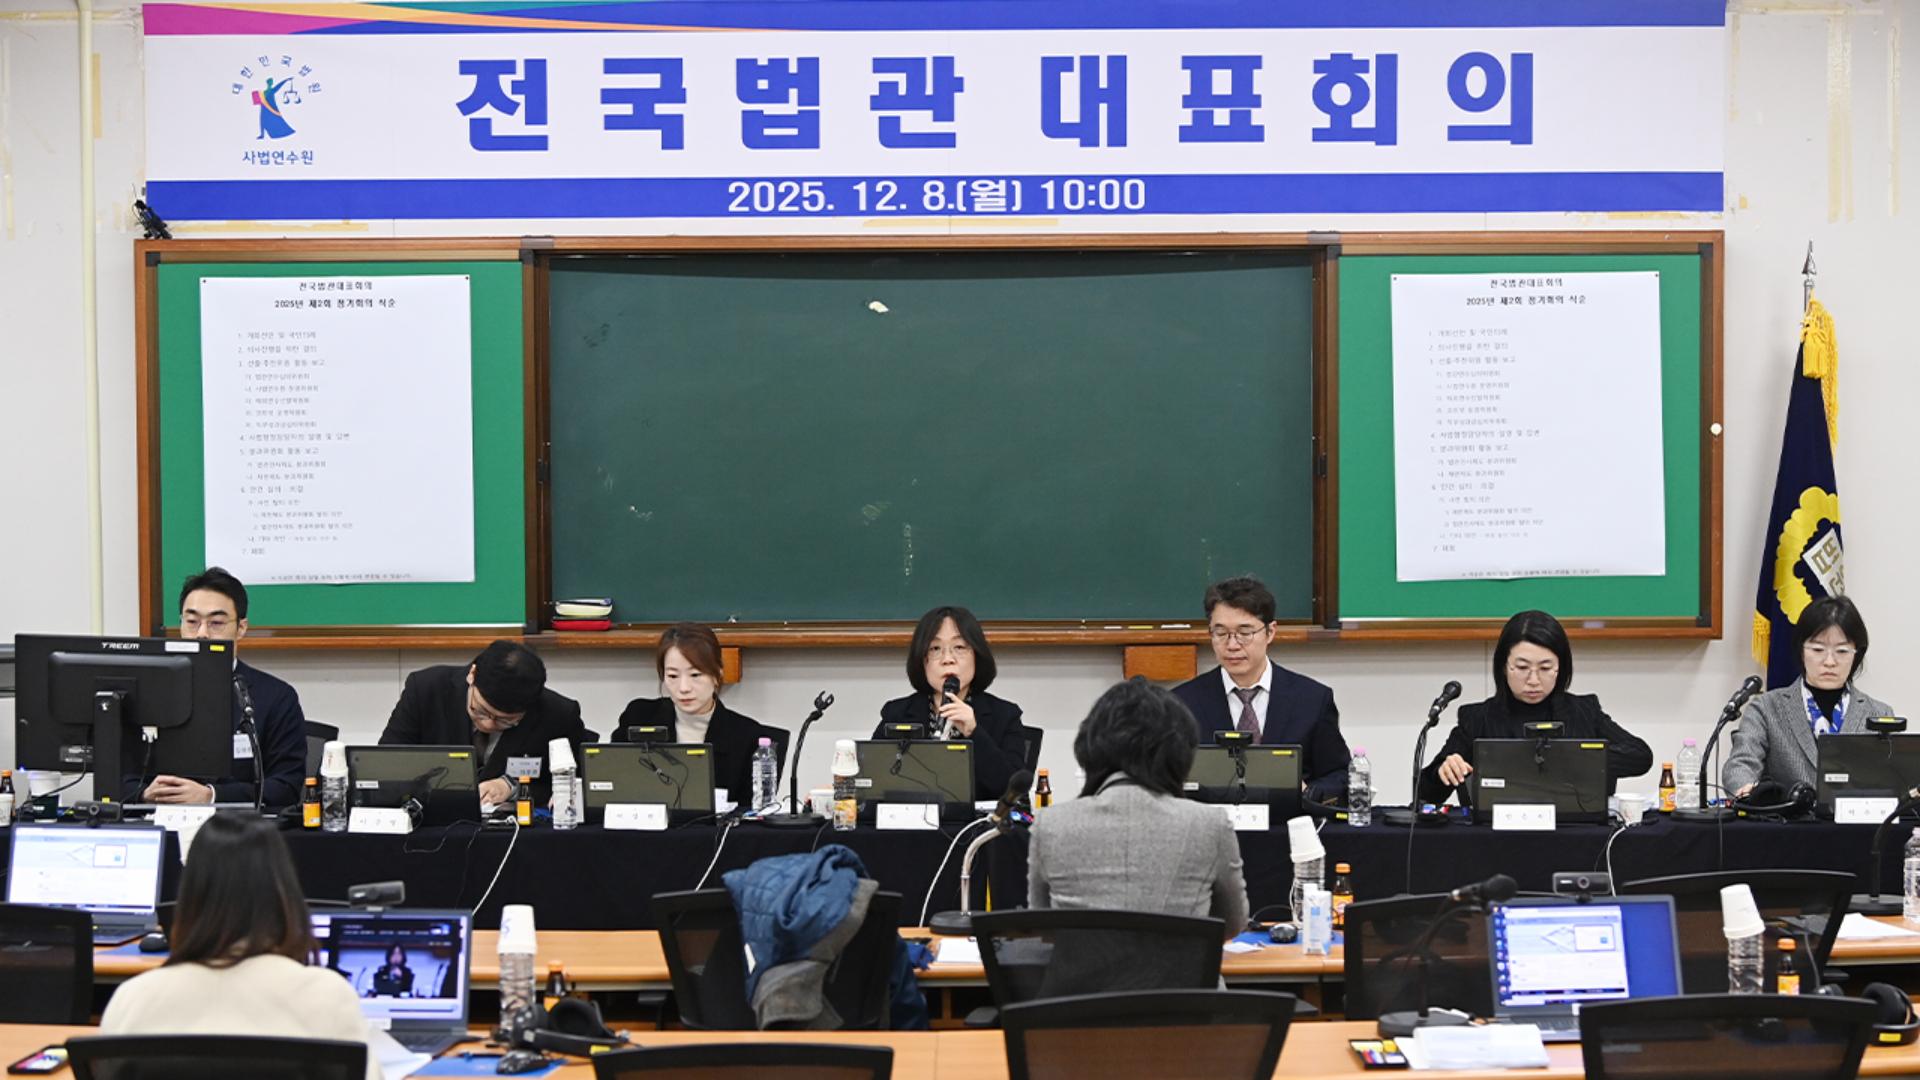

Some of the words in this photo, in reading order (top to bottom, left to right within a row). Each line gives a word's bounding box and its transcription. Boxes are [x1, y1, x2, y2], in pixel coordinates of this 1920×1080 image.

[231, 54, 322, 95] 대한민국법원
[242, 149, 314, 166] 사법연수원
[728, 181, 834, 213] 2025.
[853, 181, 908, 212] 12.
[1041, 179, 1146, 212] 10:00
[299, 281, 373, 292] 전국법관대표회의
[1490, 278, 1563, 289] 전국법관대표회의
[274, 299, 304, 309] 2025년
[308, 299, 332, 309] 제2회
[378, 298, 396, 308] 식순
[1466, 297, 1495, 307] 2025년
[1500, 296, 1522, 306] 제2회
[1569, 295, 1586, 304] 식순
